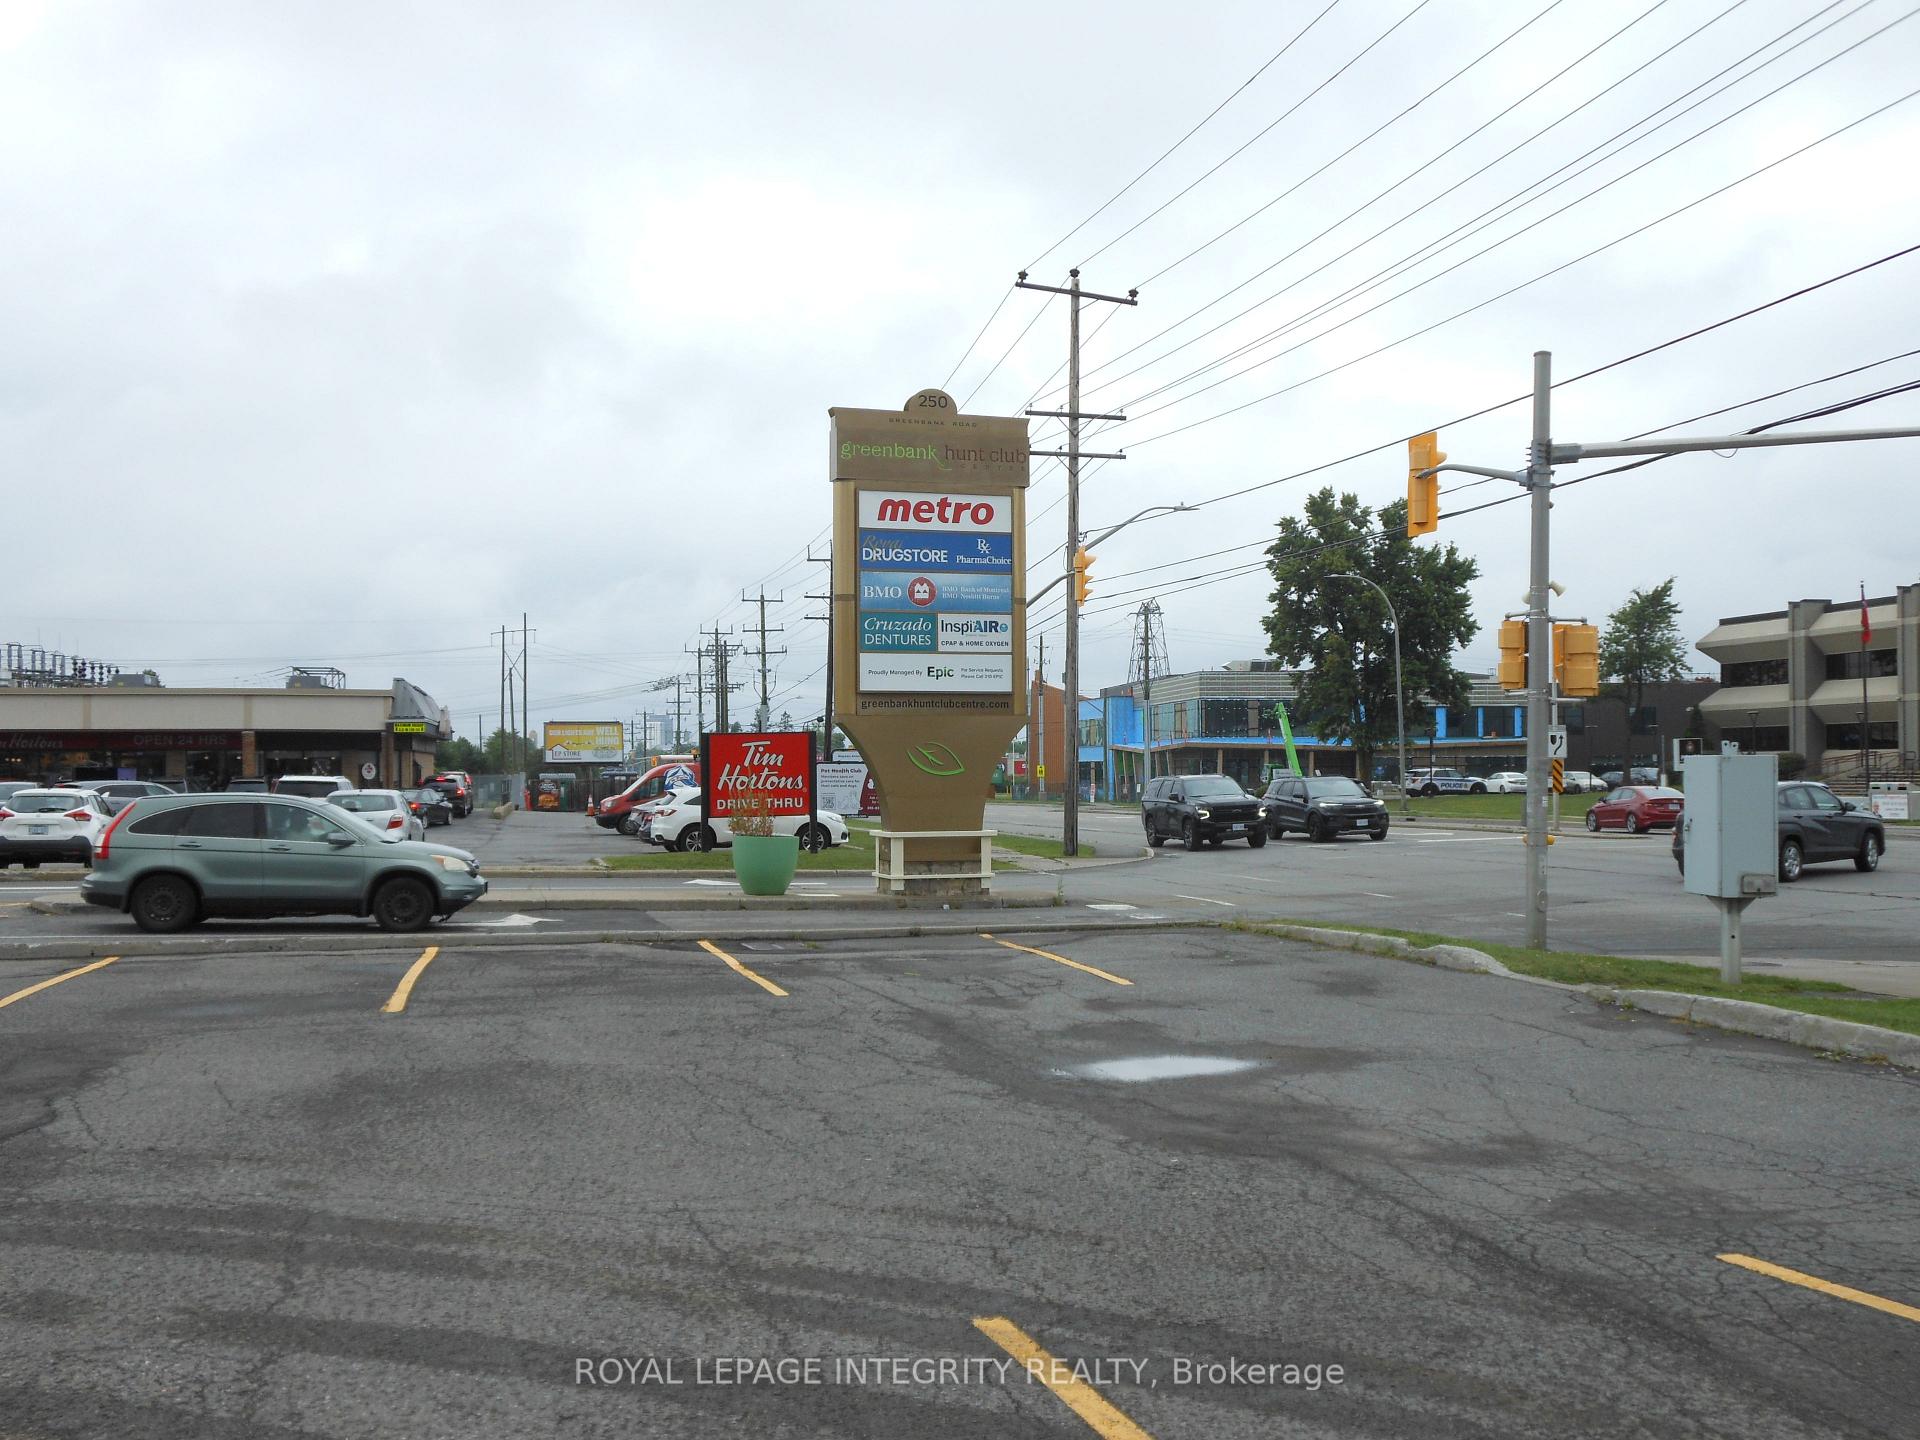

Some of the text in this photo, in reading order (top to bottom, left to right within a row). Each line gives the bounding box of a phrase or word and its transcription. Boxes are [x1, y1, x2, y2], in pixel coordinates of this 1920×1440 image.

[919, 395, 948, 408] 250
[840, 441, 1026, 464] greenbank hunt club
[878, 496, 994, 525] metro
[862, 548, 948, 563] DRUGSTORE
[956, 556, 1012, 565] PharmaChoice
[864, 586, 901, 598] BMO
[864, 618, 932, 631] Cruzado
[865, 634, 931, 646] DENTURES
[927, 666, 954, 680] Epic
[862, 700, 1009, 710] greenbankhuntclubcentre.com
[134, 735, 173, 745] OPEN
[198, 735, 226, 745] HRS
[742, 741, 784, 767] Tim
[717, 763, 803, 792] Hortons
[717, 798, 803, 810] DRIVE THRU
